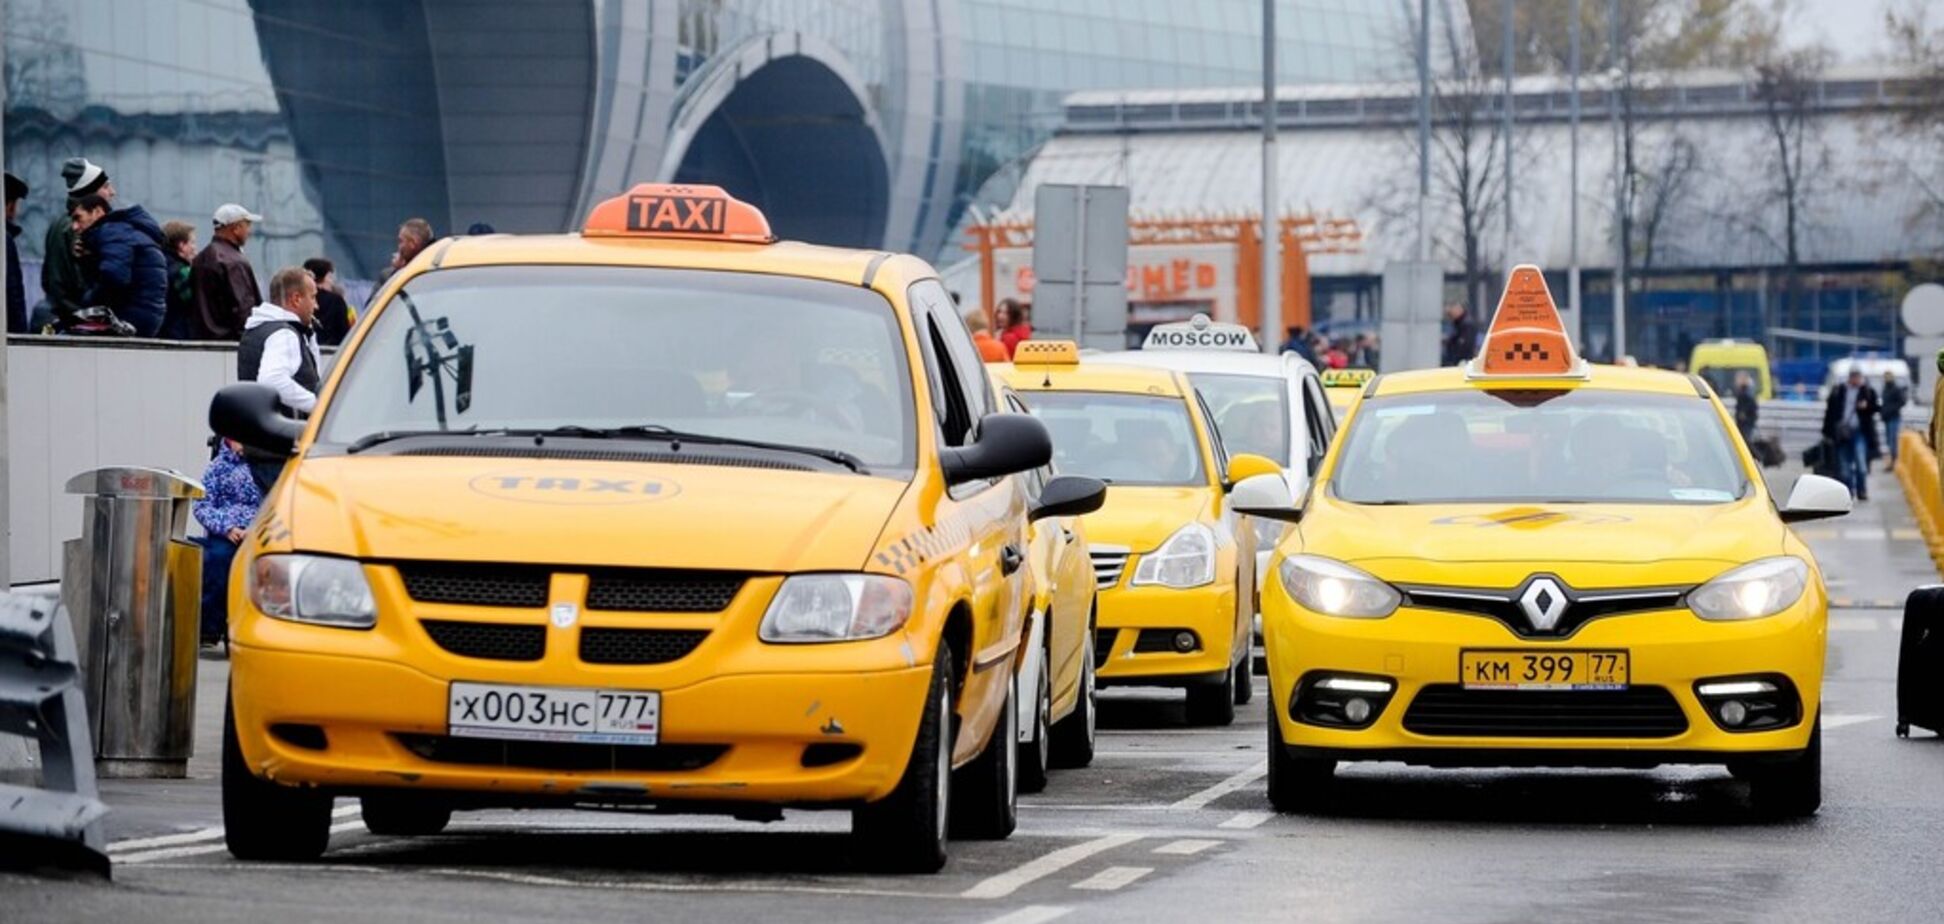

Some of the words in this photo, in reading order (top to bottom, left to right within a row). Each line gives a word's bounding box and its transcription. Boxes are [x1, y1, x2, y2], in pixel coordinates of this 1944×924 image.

[632, 197, 723, 231] TAXI
[1151, 332, 1247, 346] MOSCOW
[490, 476, 663, 495] TAXI
[1522, 655, 1574, 681] 399
[1591, 654, 1618, 674] 77
[600, 694, 650, 720] 777
